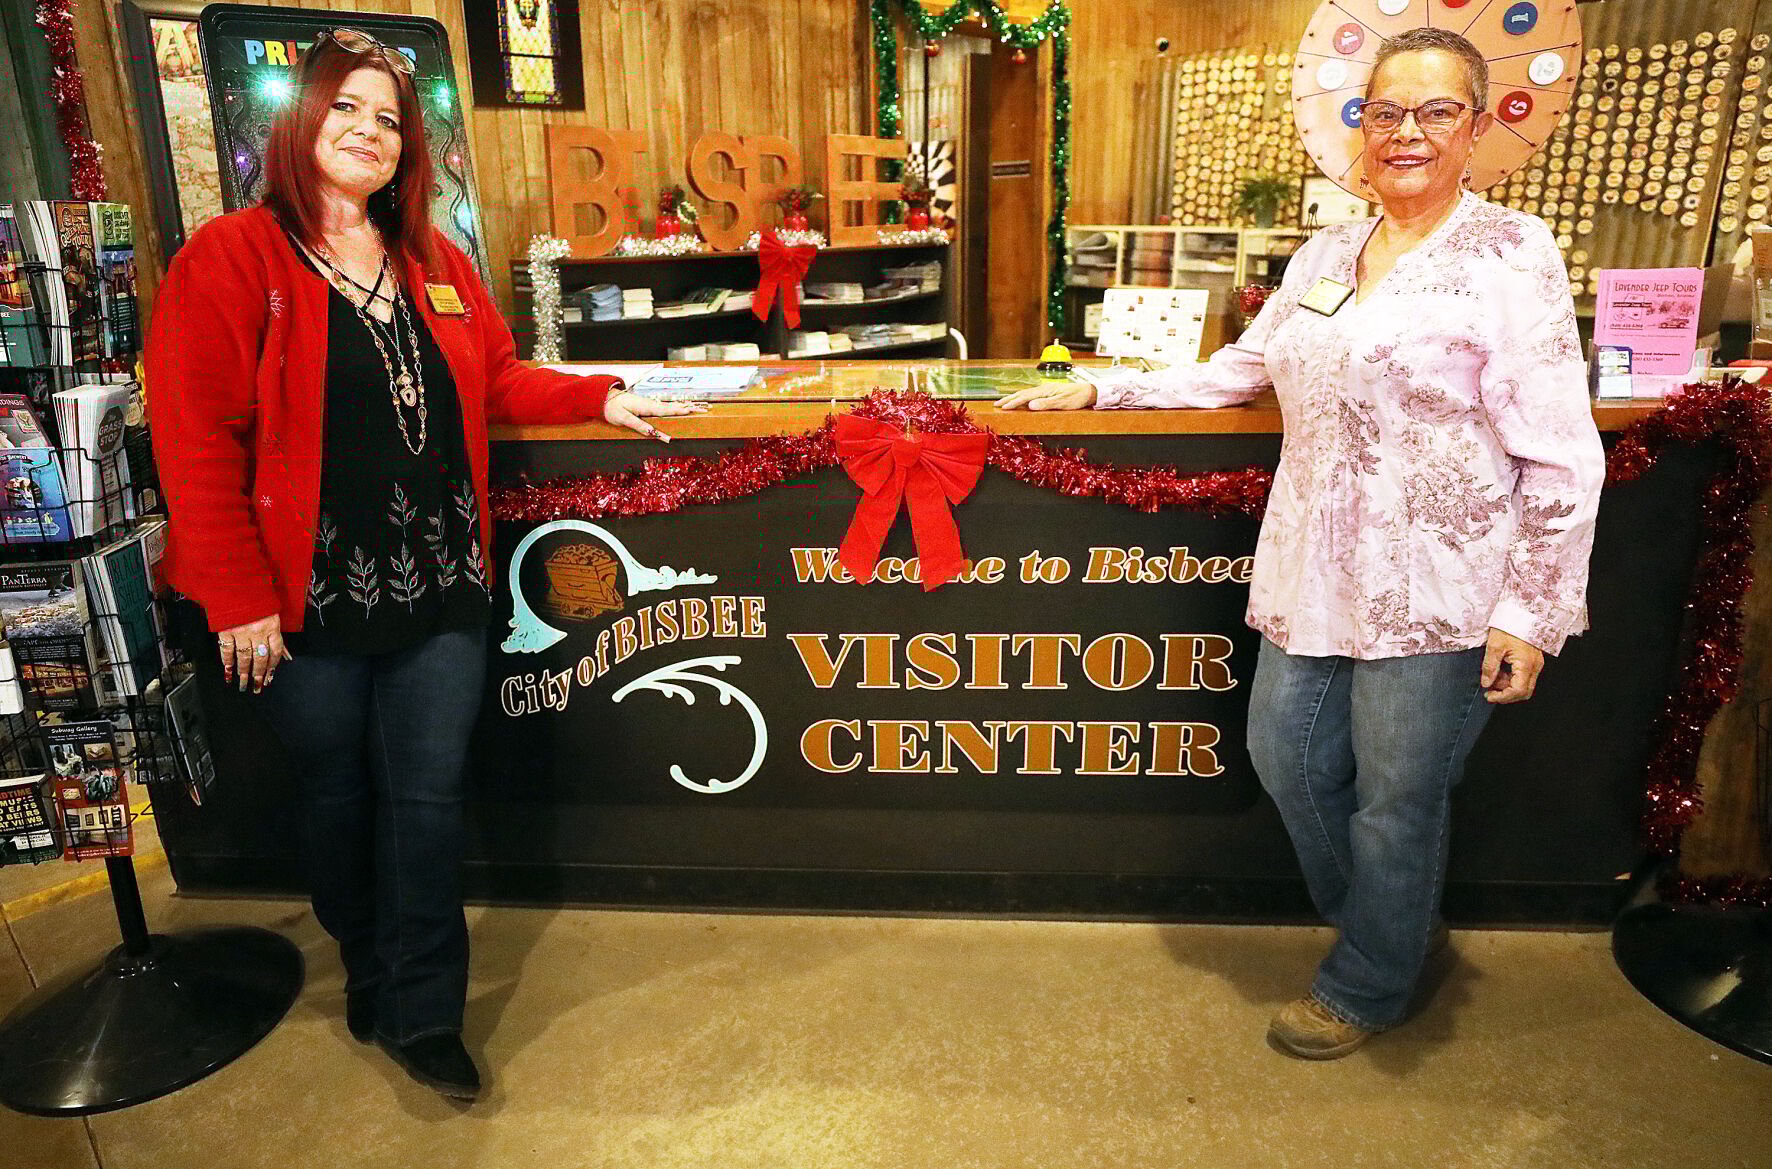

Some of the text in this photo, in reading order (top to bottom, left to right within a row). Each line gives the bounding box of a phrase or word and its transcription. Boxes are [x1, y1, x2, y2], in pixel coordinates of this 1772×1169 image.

[1614, 282, 1697, 293] LAVENDER JEEP TOURS
[99, 421, 122, 437] GRASS
[100, 433, 118, 447] STOP
[1019, 549, 1071, 585] to
[1082, 546, 1256, 584] Bisbee
[501, 595, 767, 717] City of BISBEE
[786, 633, 1239, 691] VISITOR
[800, 719, 1226, 778] CENTER
[8, 801, 37, 813] EATS
